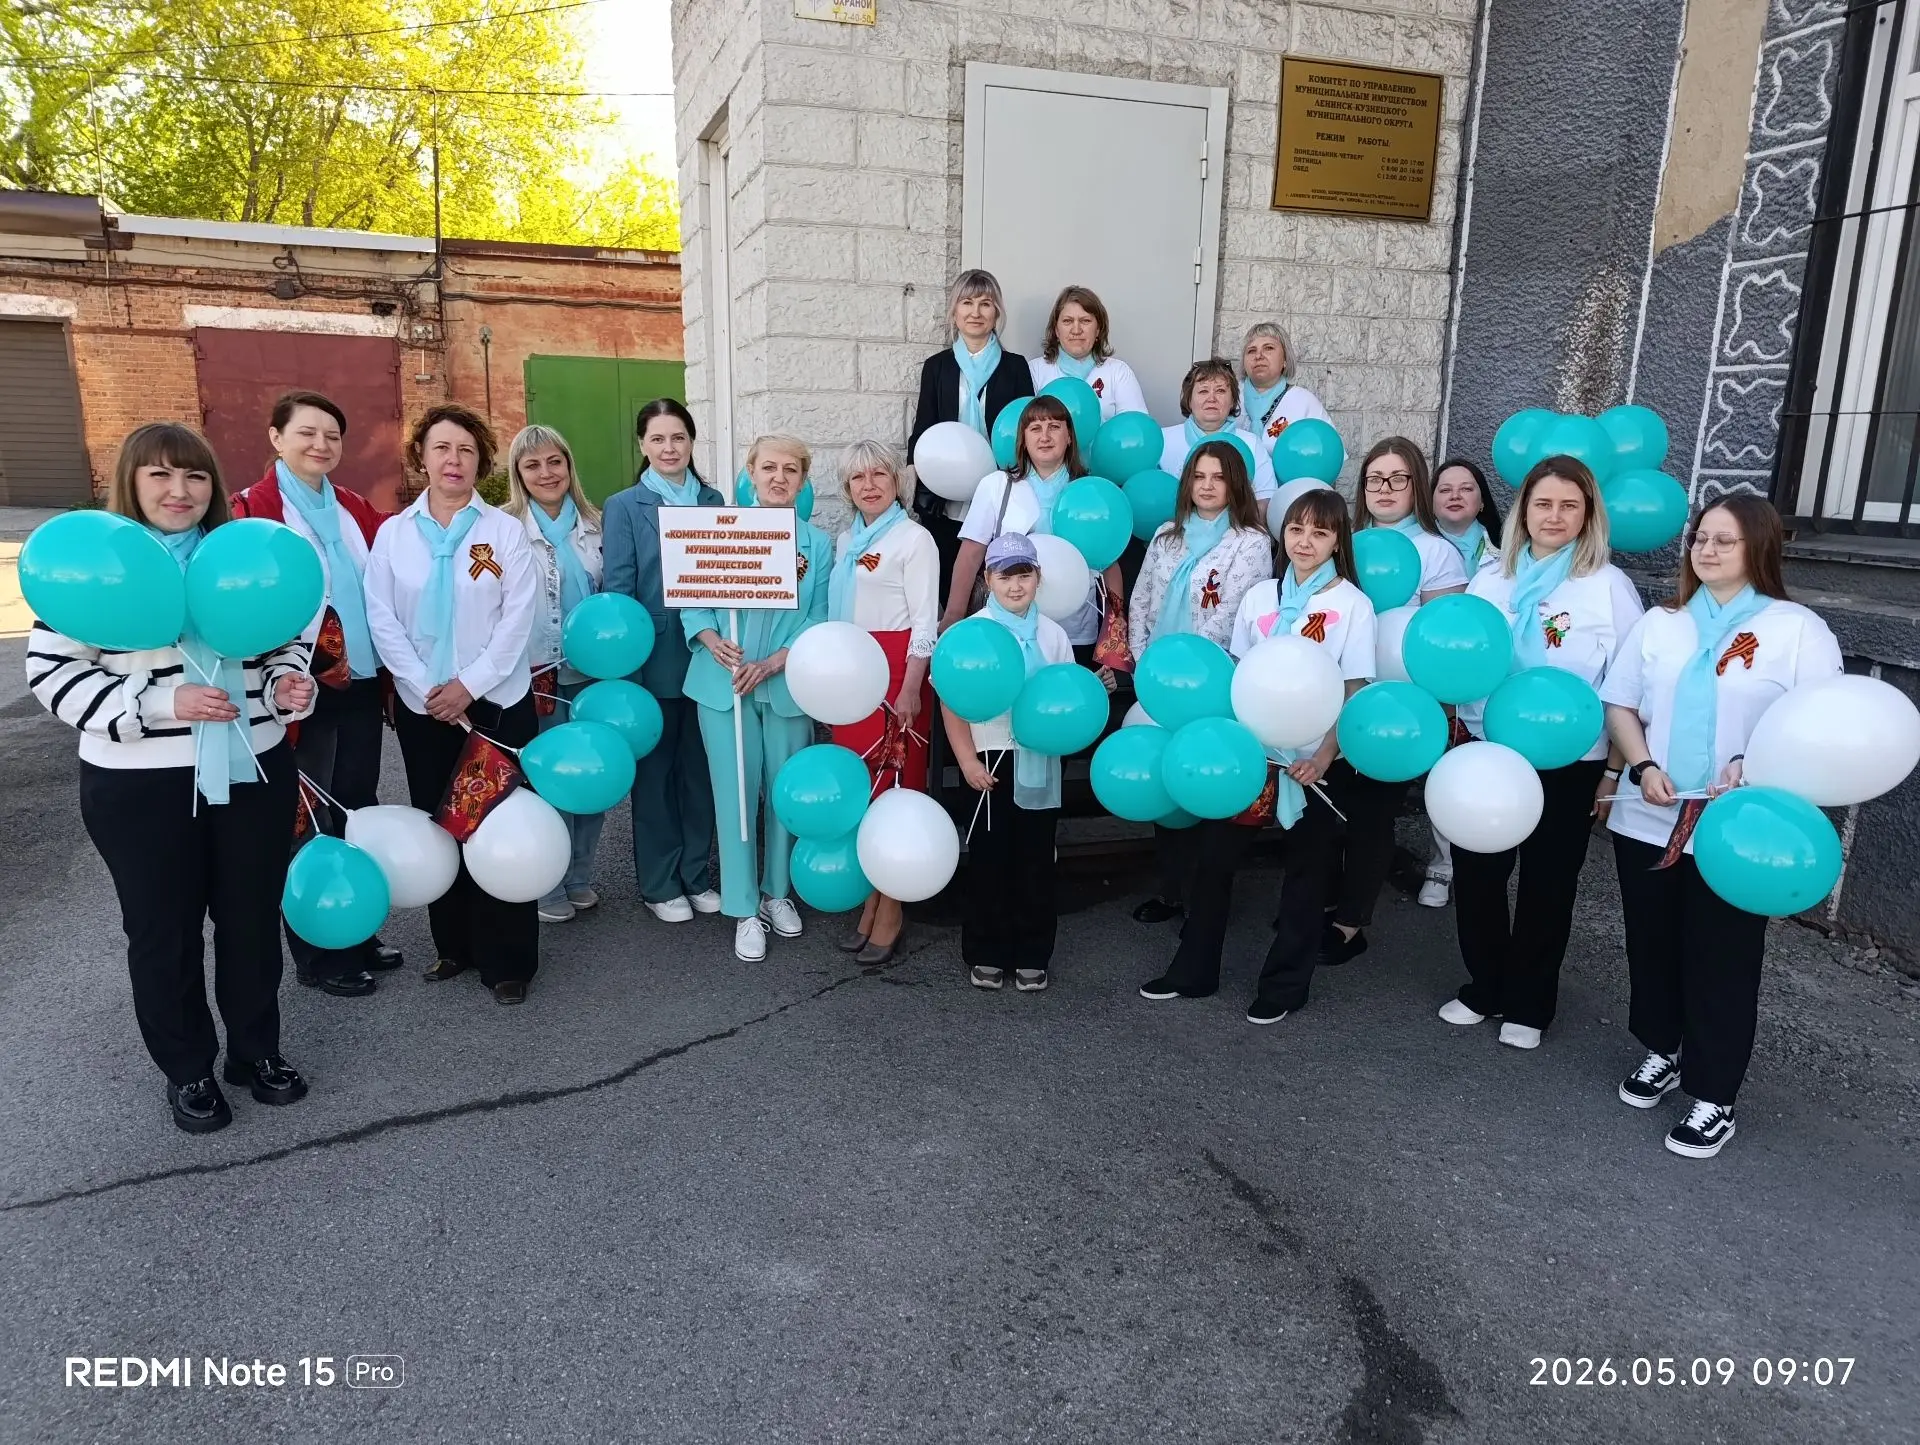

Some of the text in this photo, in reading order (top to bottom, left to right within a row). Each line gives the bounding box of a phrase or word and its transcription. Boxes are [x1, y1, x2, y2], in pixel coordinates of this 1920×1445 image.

[1308, 74, 1417, 94] КОМИТЕТ ПО УПРАВЛЕНИЮ
[1295, 85, 1428, 107] МУНИЦИПАЛЬНЫМ ИМУЩЕСТВОМ
[1314, 99, 1408, 117] ЛЕНИНСК-КУЗНЕЦКОГО
[1306, 110, 1414, 129] МУНИЦИПАЛЬНОГО ОКРУГА
[1316, 132, 1345, 143] РЕЖИМ
[1293, 156, 1322, 166] ПЯТНИЦА
[1398, 166, 1408, 174] ДО
[1399, 158, 1409, 166] ДО
[1410, 159, 1425, 167] 17:00
[1292, 164, 1309, 173] ОБЕД
[1398, 174, 1408, 182] ДО
[716, 515, 739, 525] МКУ
[665, 530, 791, 541] «КОМИТЕТ ПО УПРАВЛЕНИЮ
[685, 545, 772, 556] МУНИЦИПАЛЬНЫМ
[696, 560, 762, 570] ИМУЩЕСТВОМ
[677, 575, 782, 586] ЛЕНИНСК-КУЗНЕЦКОГО
[666, 589, 795, 600] МУНИЦИПАЛЬНОГО ОКРУГА»
